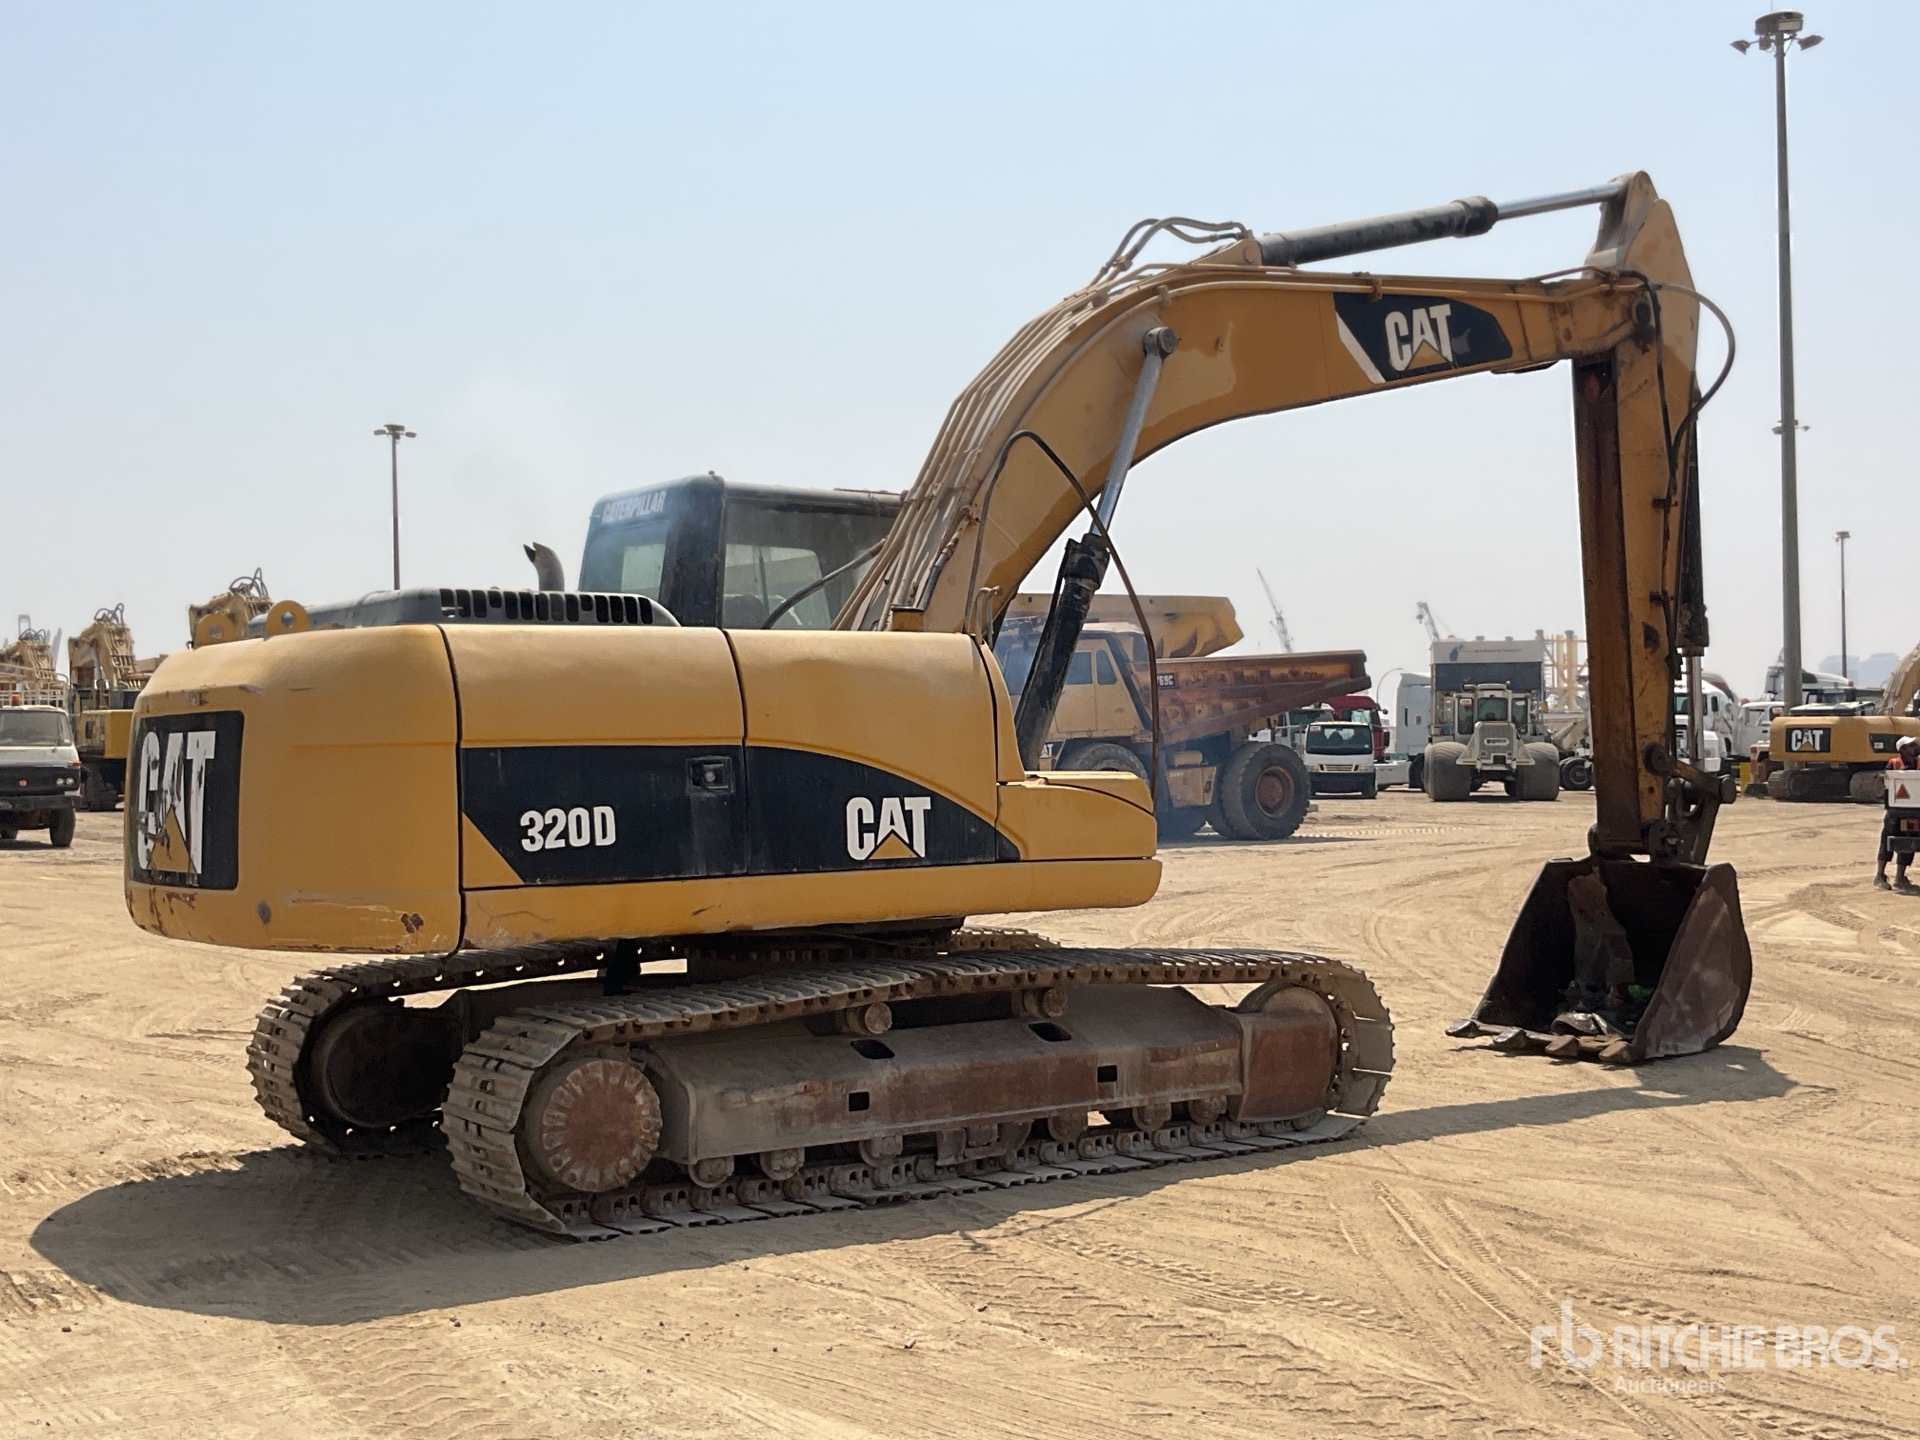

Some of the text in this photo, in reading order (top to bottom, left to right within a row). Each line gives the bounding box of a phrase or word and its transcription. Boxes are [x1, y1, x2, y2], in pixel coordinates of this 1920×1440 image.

[1385, 304, 1453, 371] CAT
[602, 490, 667, 523] CATERPILLAR
[1791, 729, 1823, 752] CAT
[138, 731, 216, 874] CAT
[520, 806, 616, 852] 320D
[846, 797, 931, 861] CAT
